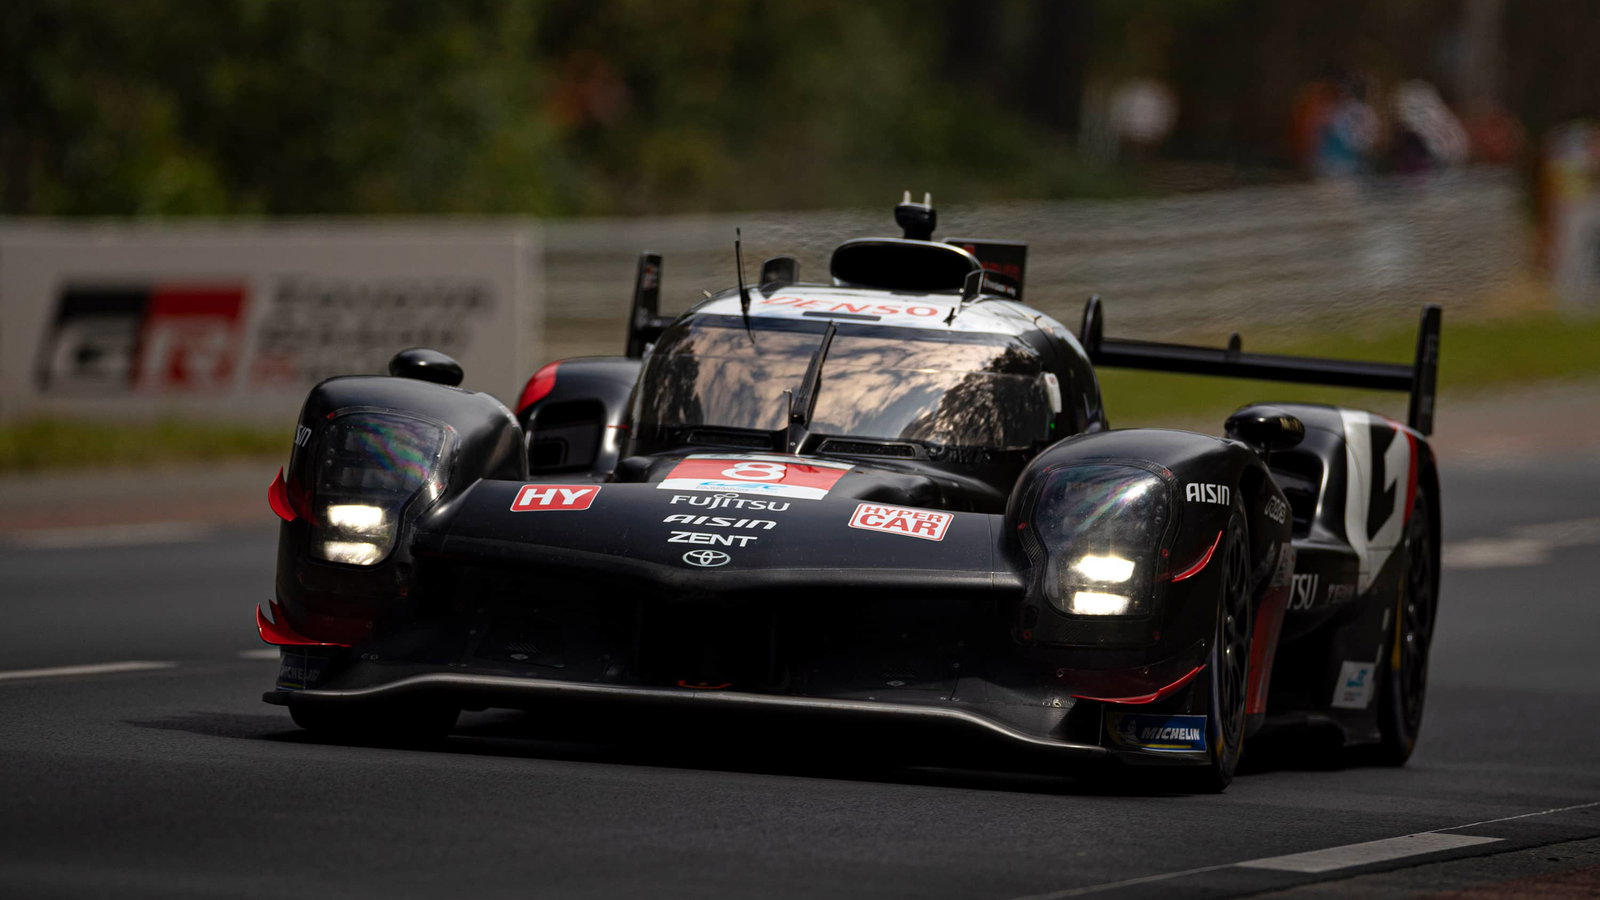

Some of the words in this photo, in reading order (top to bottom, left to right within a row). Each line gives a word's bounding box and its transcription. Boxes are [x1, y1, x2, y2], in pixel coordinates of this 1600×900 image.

[759, 296, 938, 317] DENSO
[721, 461, 787, 481] 8
[519, 488, 593, 506] HY
[669, 493, 791, 512] FUJITSU
[1185, 482, 1231, 506] AISIN
[662, 514, 777, 530] AISIN
[864, 506, 944, 523] HYPER
[859, 513, 939, 536] CAR
[667, 530, 758, 548] ZENT
[1140, 727, 1200, 741] MICHELIN
